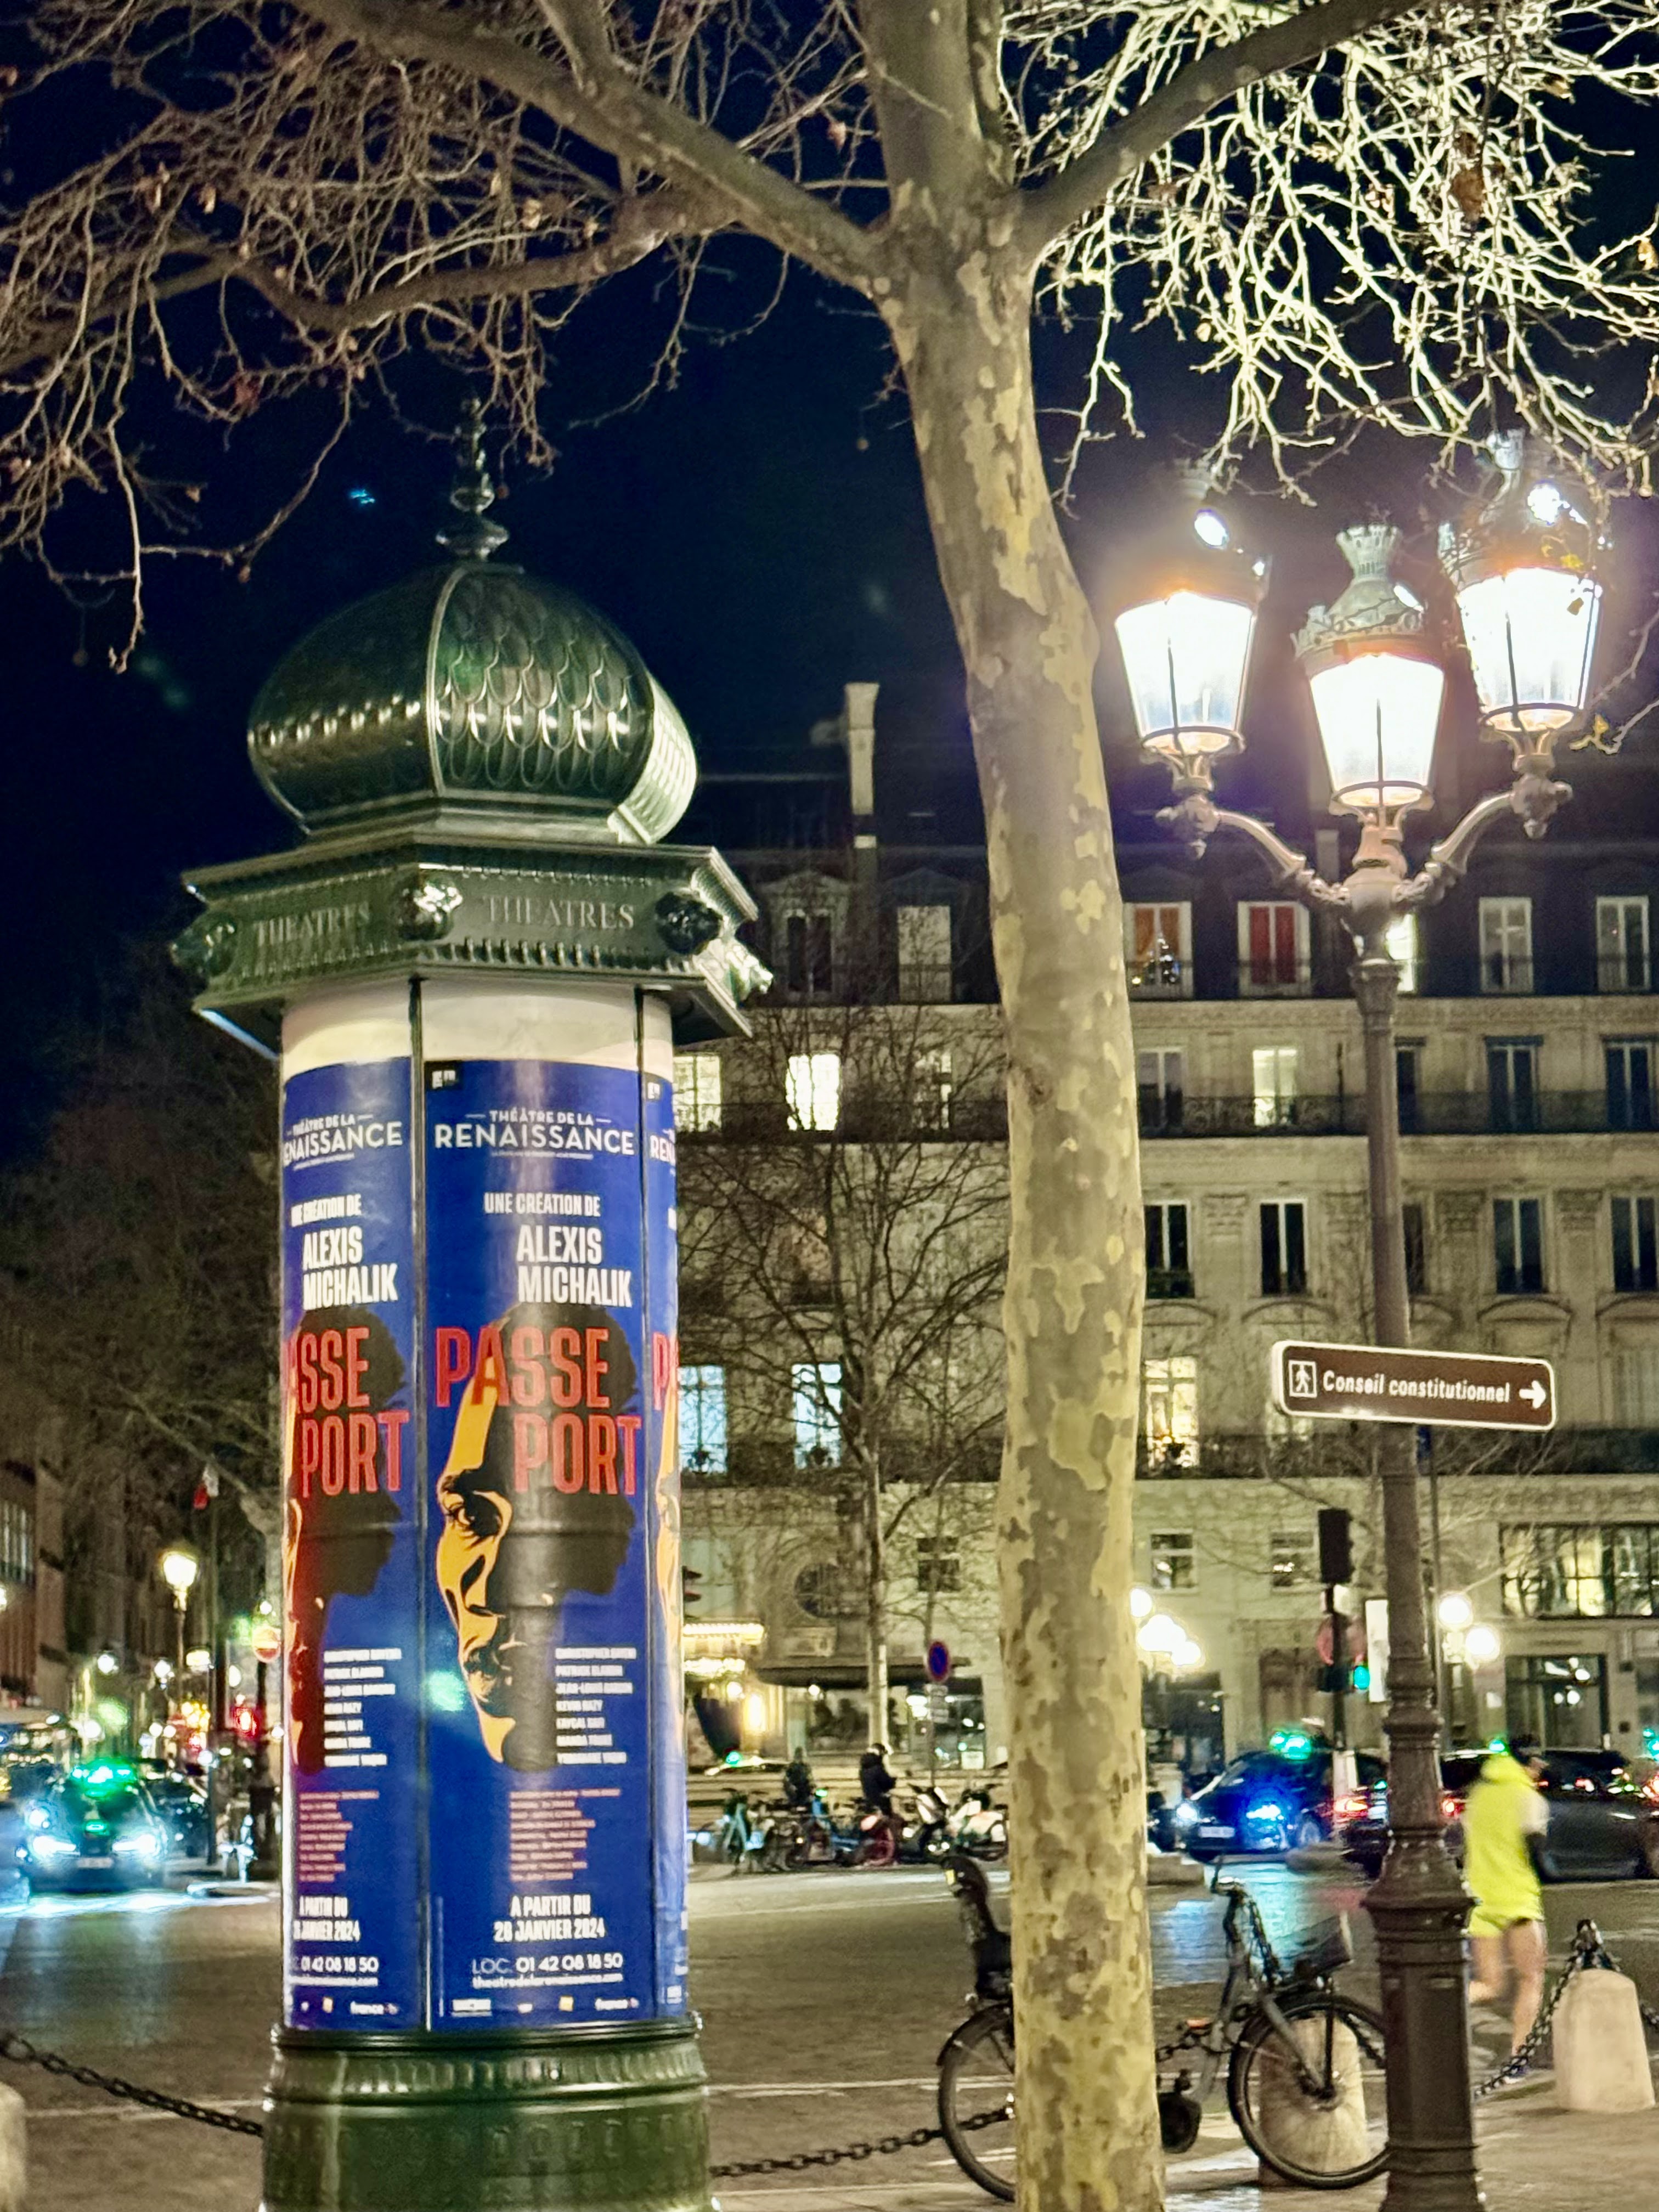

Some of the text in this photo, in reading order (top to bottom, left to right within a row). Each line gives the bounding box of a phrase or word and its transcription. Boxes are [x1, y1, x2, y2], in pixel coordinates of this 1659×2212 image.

[482, 895, 635, 930] THEATRES
[489, 1107, 594, 1126] THÉÂTRE DE LA
[283, 1121, 403, 1167] ENAISSANCE
[435, 1122, 635, 1155] RENAISSANCE
[484, 1191, 601, 1217] UNE CRÉATION DE
[302, 1225, 363, 1271] ALEXIS
[516, 1224, 602, 1265] ALEXIS
[302, 1263, 399, 1310] MICHALIK
[517, 1266, 633, 1308] MICHALIK
[436, 1325, 611, 1408] PASSE
[1323, 1370, 1510, 1403] Conseil constitutionnel
[301, 1409, 410, 1498] PORT
[514, 1412, 642, 1496] PORT
[523, 1894, 571, 1917] PARTIR
[573, 1894, 591, 1915] DU
[515, 1918, 572, 1942] JANVIER
[574, 1917, 606, 1939] 2024
[358, 1955, 379, 1973] 50
[516, 1956, 535, 1973] 01
[538, 1955, 559, 1972] 42
[561, 1954, 584, 1970] 08
[586, 1954, 601, 1969] 18
[603, 1953, 623, 1968] 50
